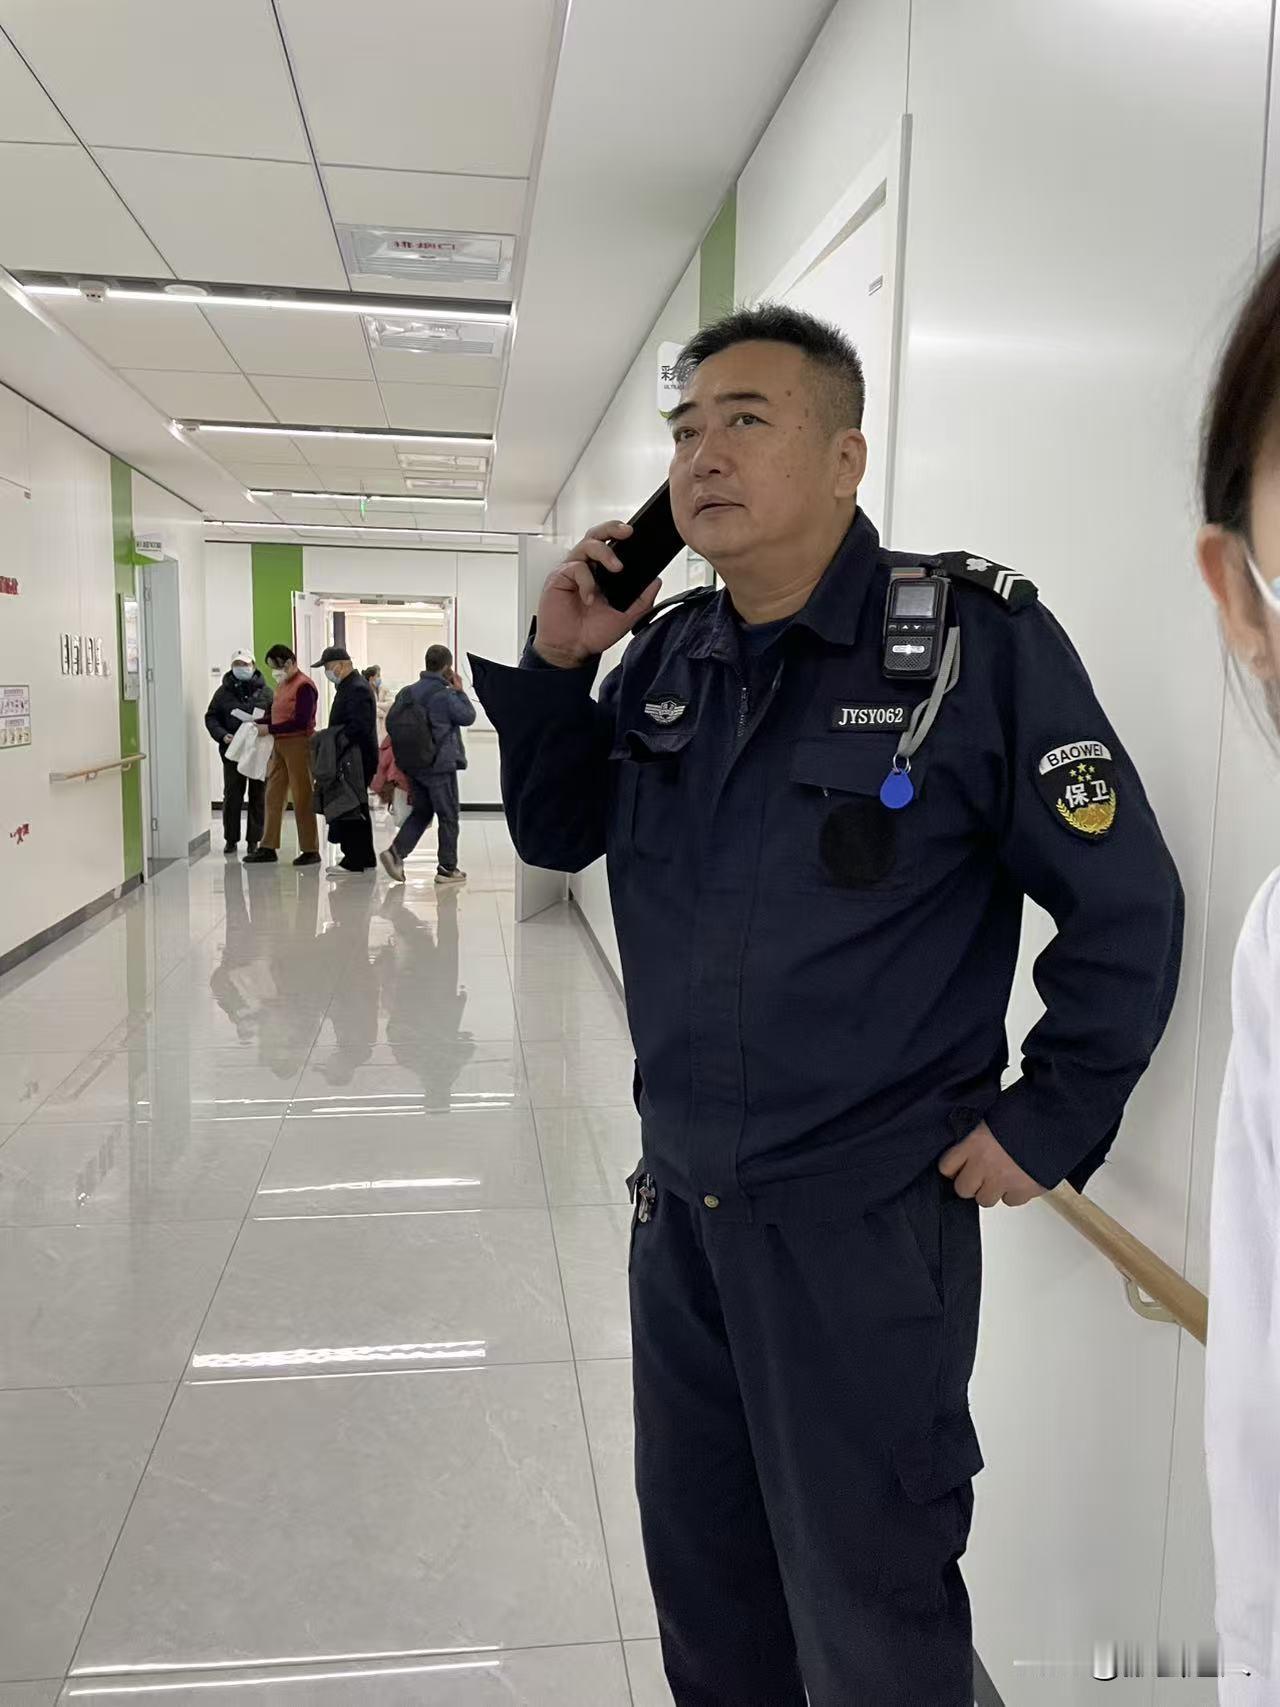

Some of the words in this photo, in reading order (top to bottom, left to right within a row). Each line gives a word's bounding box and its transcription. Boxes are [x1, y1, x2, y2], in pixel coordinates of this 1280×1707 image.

[838, 707, 904, 725] JYSY062
[1046, 743, 1103, 767] BAOWEI
[1065, 779, 1110, 808] 保卫
